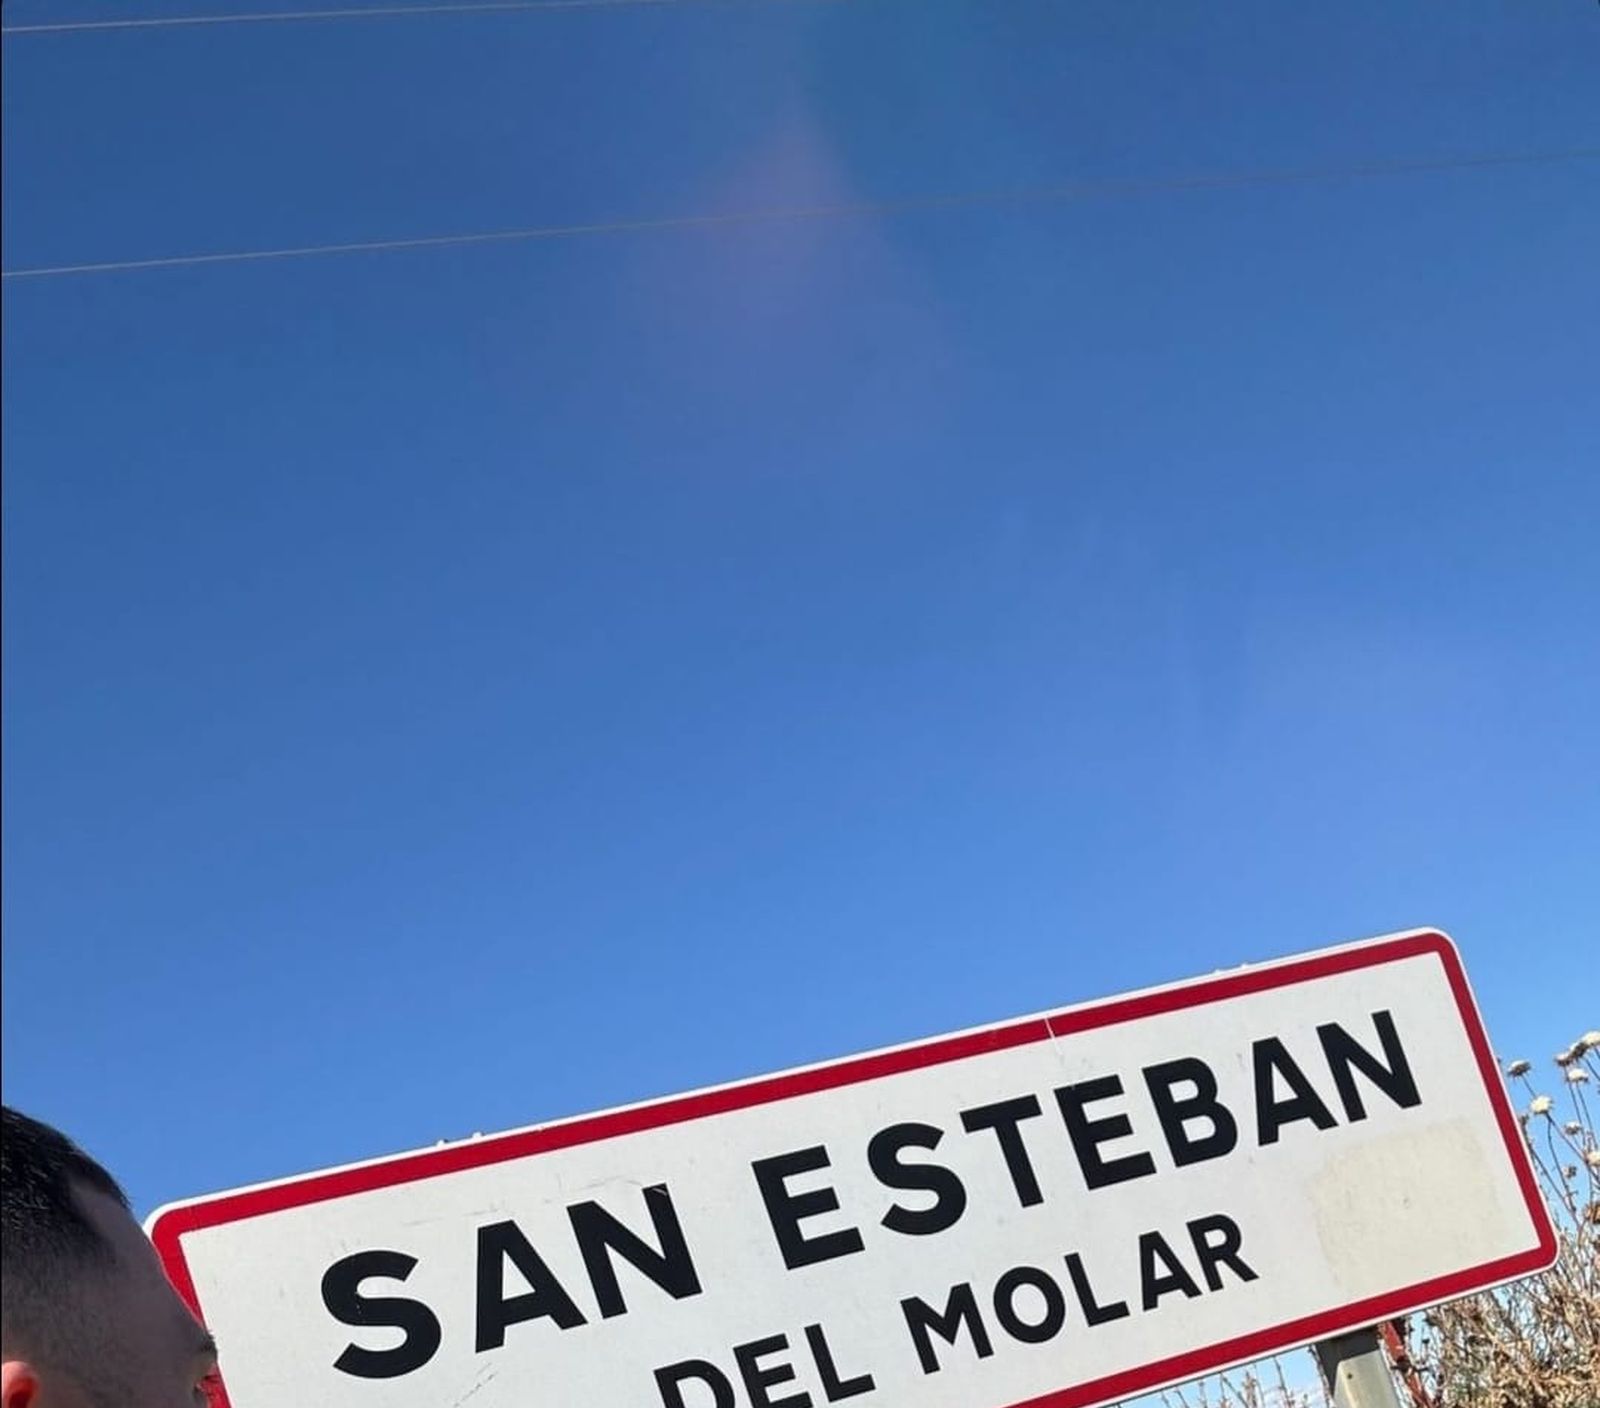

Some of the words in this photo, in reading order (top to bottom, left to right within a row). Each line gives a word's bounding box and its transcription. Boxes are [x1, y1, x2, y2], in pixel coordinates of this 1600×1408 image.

[321, 1183, 703, 1379] SAN
[751, 1010, 1422, 1271] ESTEBAN
[900, 1214, 1259, 1375] MOLAR
